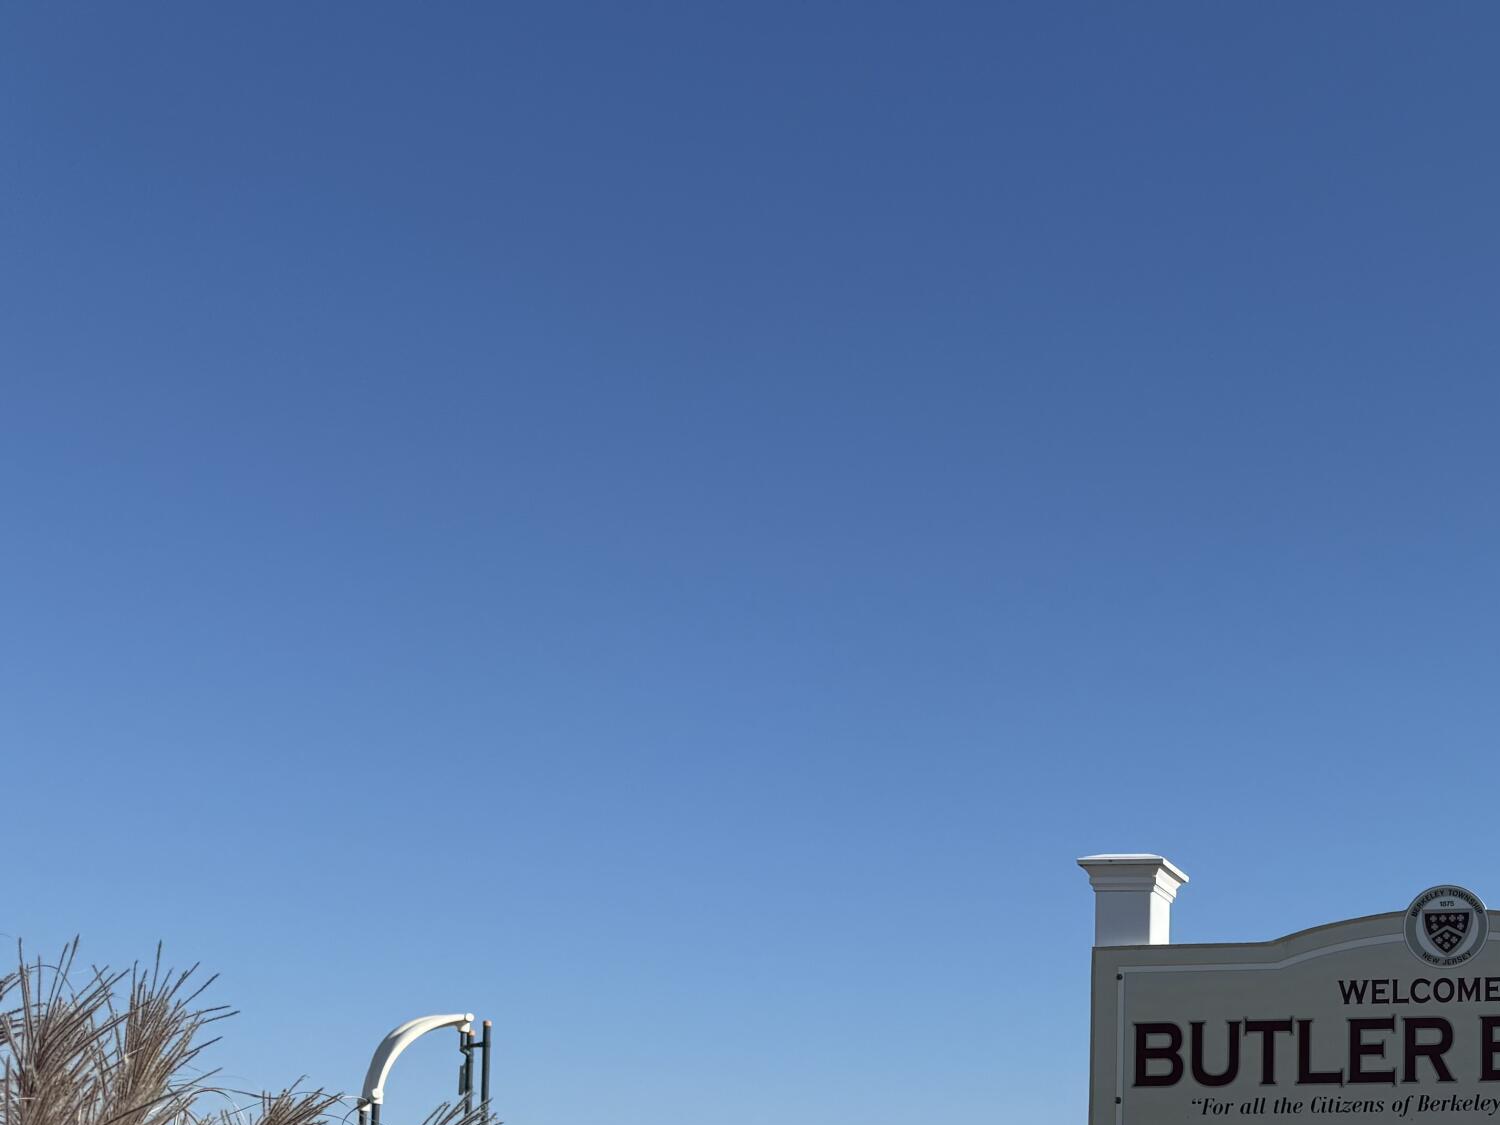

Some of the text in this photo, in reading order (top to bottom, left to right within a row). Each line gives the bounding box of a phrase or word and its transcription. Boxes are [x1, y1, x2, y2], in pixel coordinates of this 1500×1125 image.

[1411, 888, 1483, 917] BERKELEY TOWNSHIP
[1422, 950, 1472, 966] NEW JERSEY
[1131, 1014, 1458, 1089] BUTLER
[1240, 1097, 1265, 1114] all
[1273, 1096, 1303, 1114] the
[1310, 1095, 1385, 1114] Citizens
[1391, 1094, 1414, 1117] of
